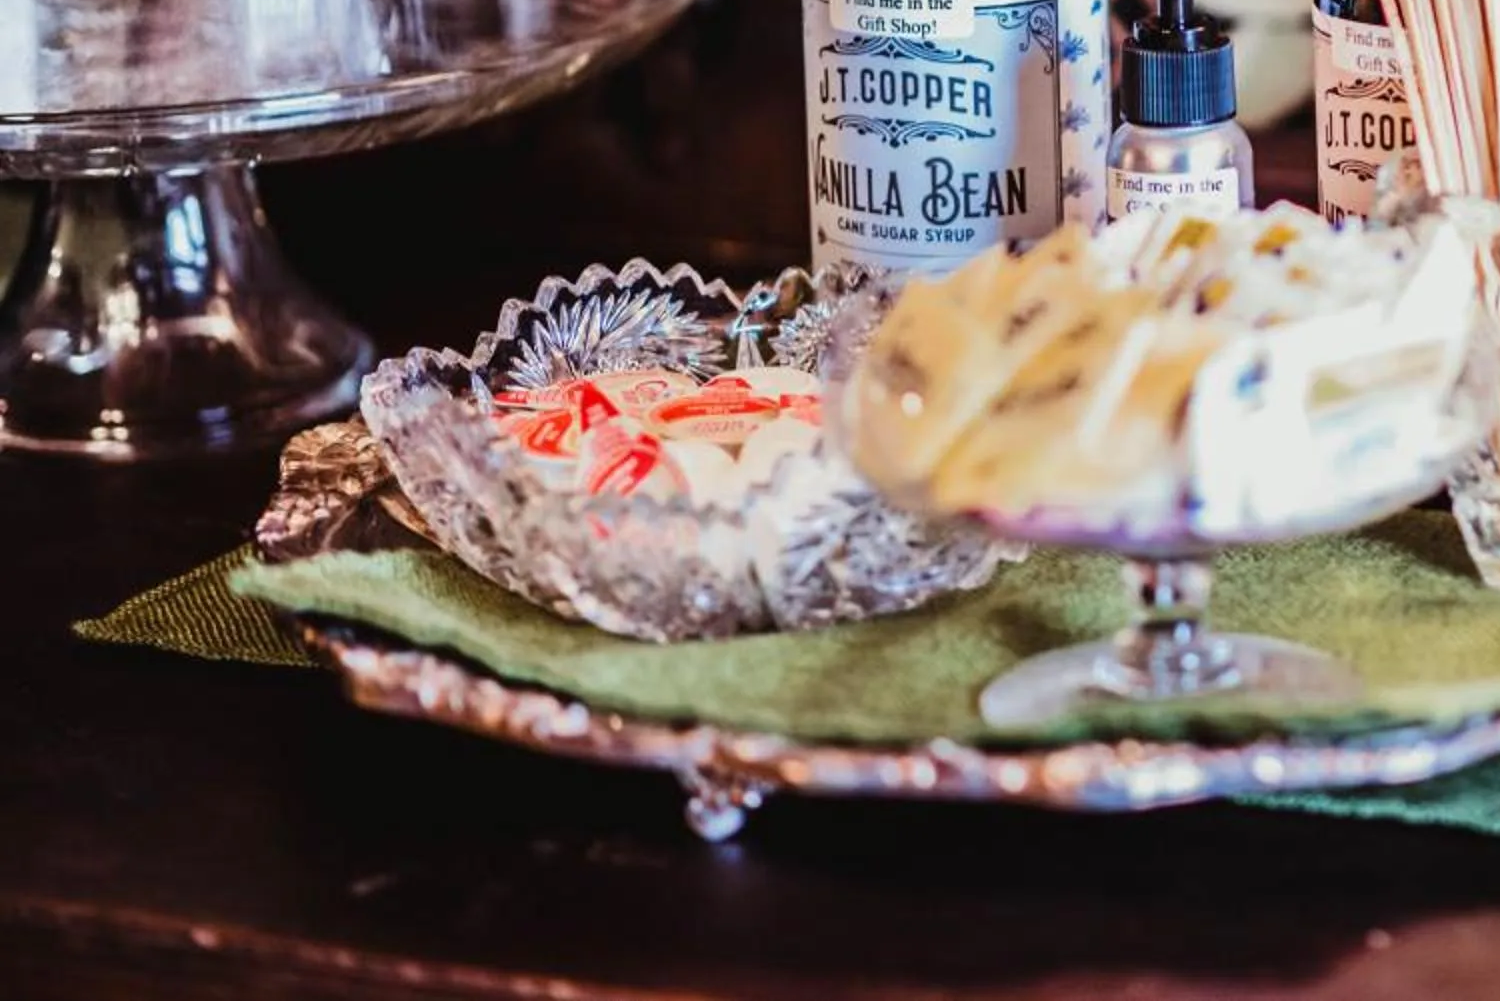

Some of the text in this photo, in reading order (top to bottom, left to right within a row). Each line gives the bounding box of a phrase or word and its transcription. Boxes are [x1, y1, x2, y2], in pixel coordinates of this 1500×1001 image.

[857, 14, 937, 38] Gift Shop!
[1345, 27, 1373, 48] Find
[1356, 55, 1383, 74] Gift
[1115, 172, 1223, 194] Find me in the
[837, 216, 975, 243] CANE SUGAR SYRUP
